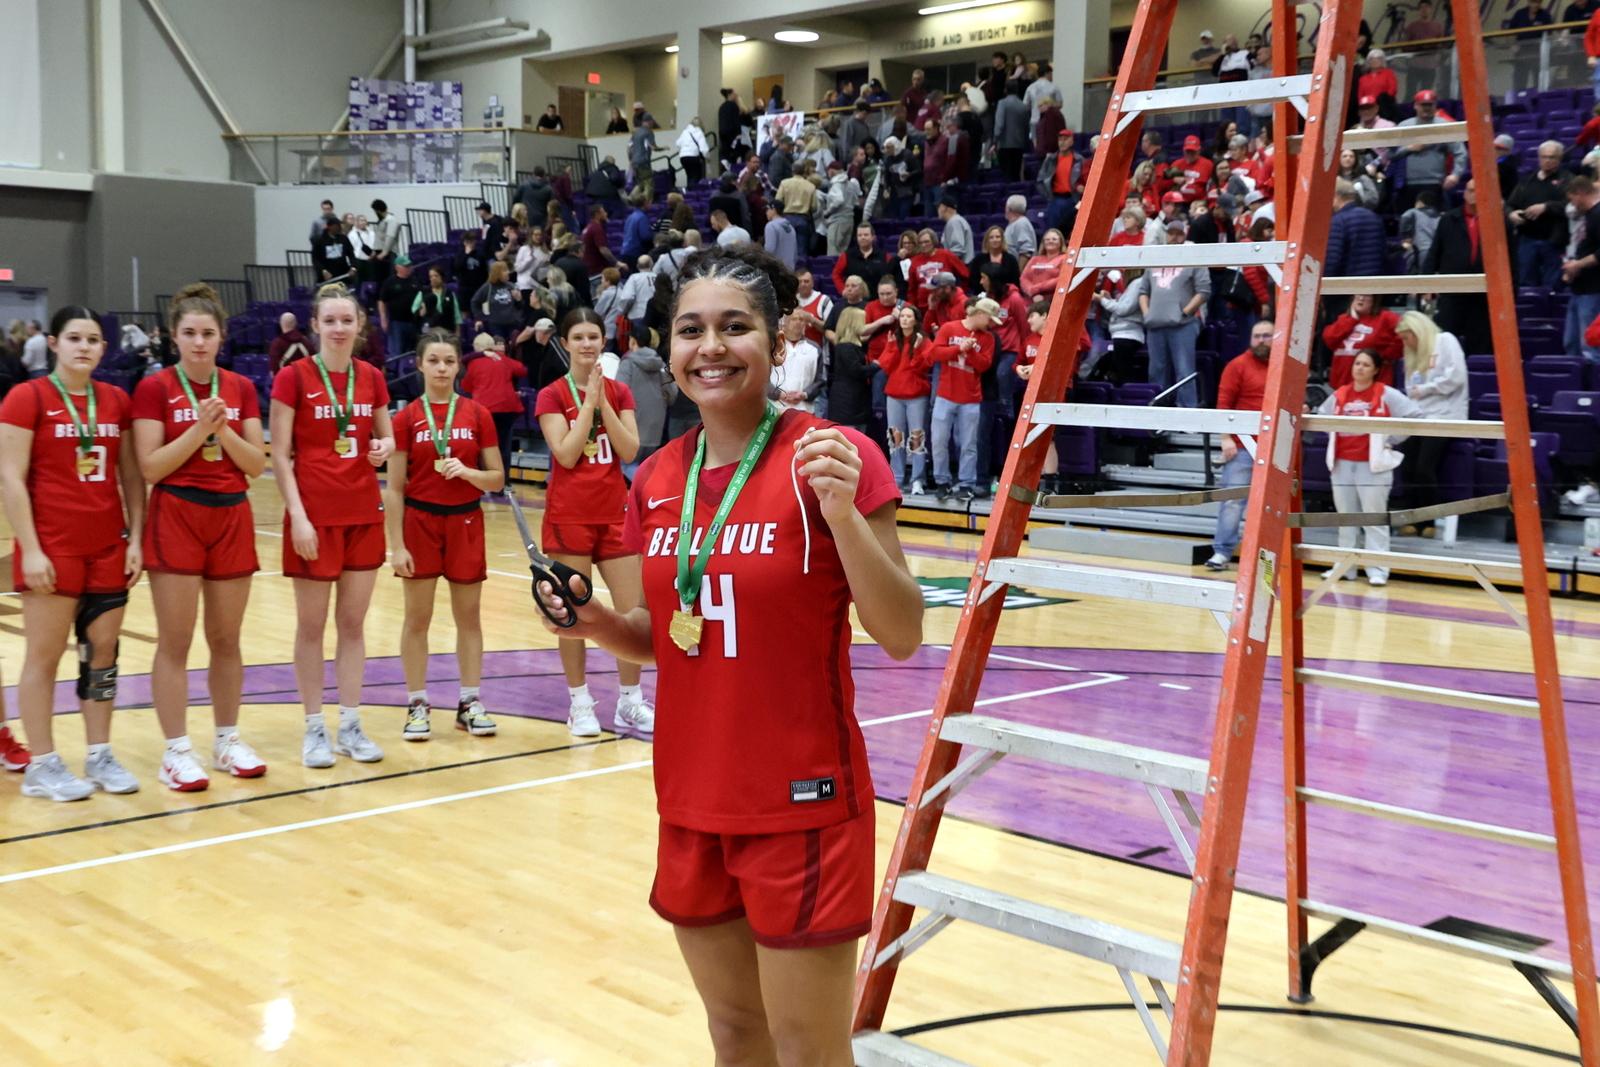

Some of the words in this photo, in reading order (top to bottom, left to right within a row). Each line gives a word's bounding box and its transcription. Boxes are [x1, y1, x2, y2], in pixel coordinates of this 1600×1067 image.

[942, 33, 962, 46] AND
[969, 26, 1007, 42] WEIGHT
[173, 407, 240, 423] BELUE
[314, 403, 373, 419] BELLVUE
[55, 423, 121, 438] BELLVUE
[416, 428, 474, 443] BELVUE
[588, 432, 613, 465] 0
[822, 783, 831, 794] M
